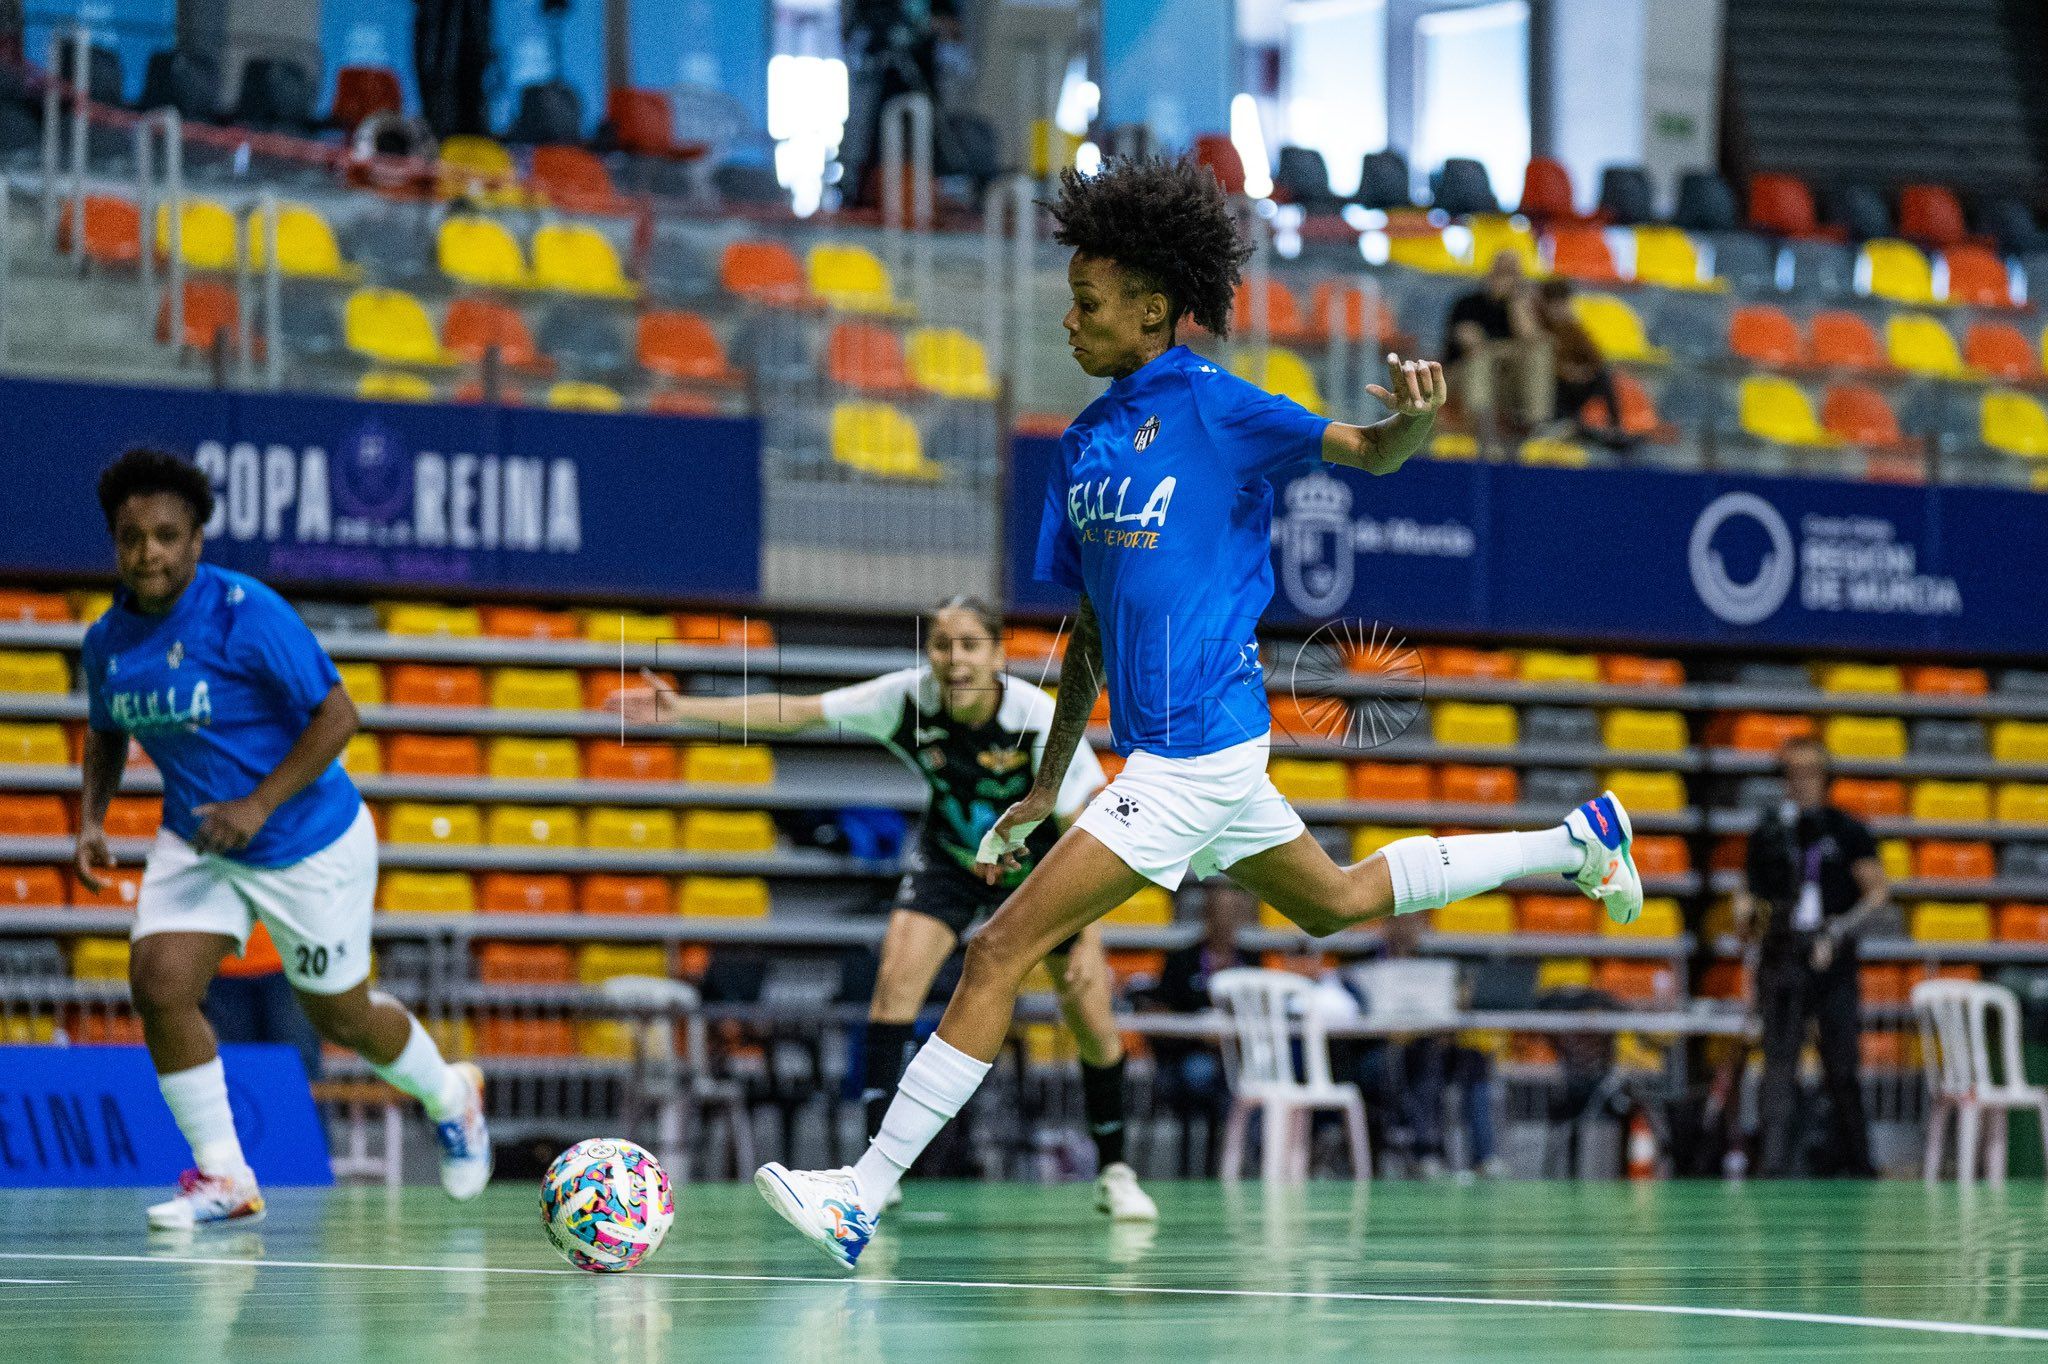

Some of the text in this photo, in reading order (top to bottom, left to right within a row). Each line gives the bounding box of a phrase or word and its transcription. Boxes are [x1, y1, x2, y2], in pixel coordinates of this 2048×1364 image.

[196, 440, 332, 542] COPA
[413, 451, 583, 554] REINA
[1104, 808, 1132, 828] KELME
[295, 943, 328, 978] 20
